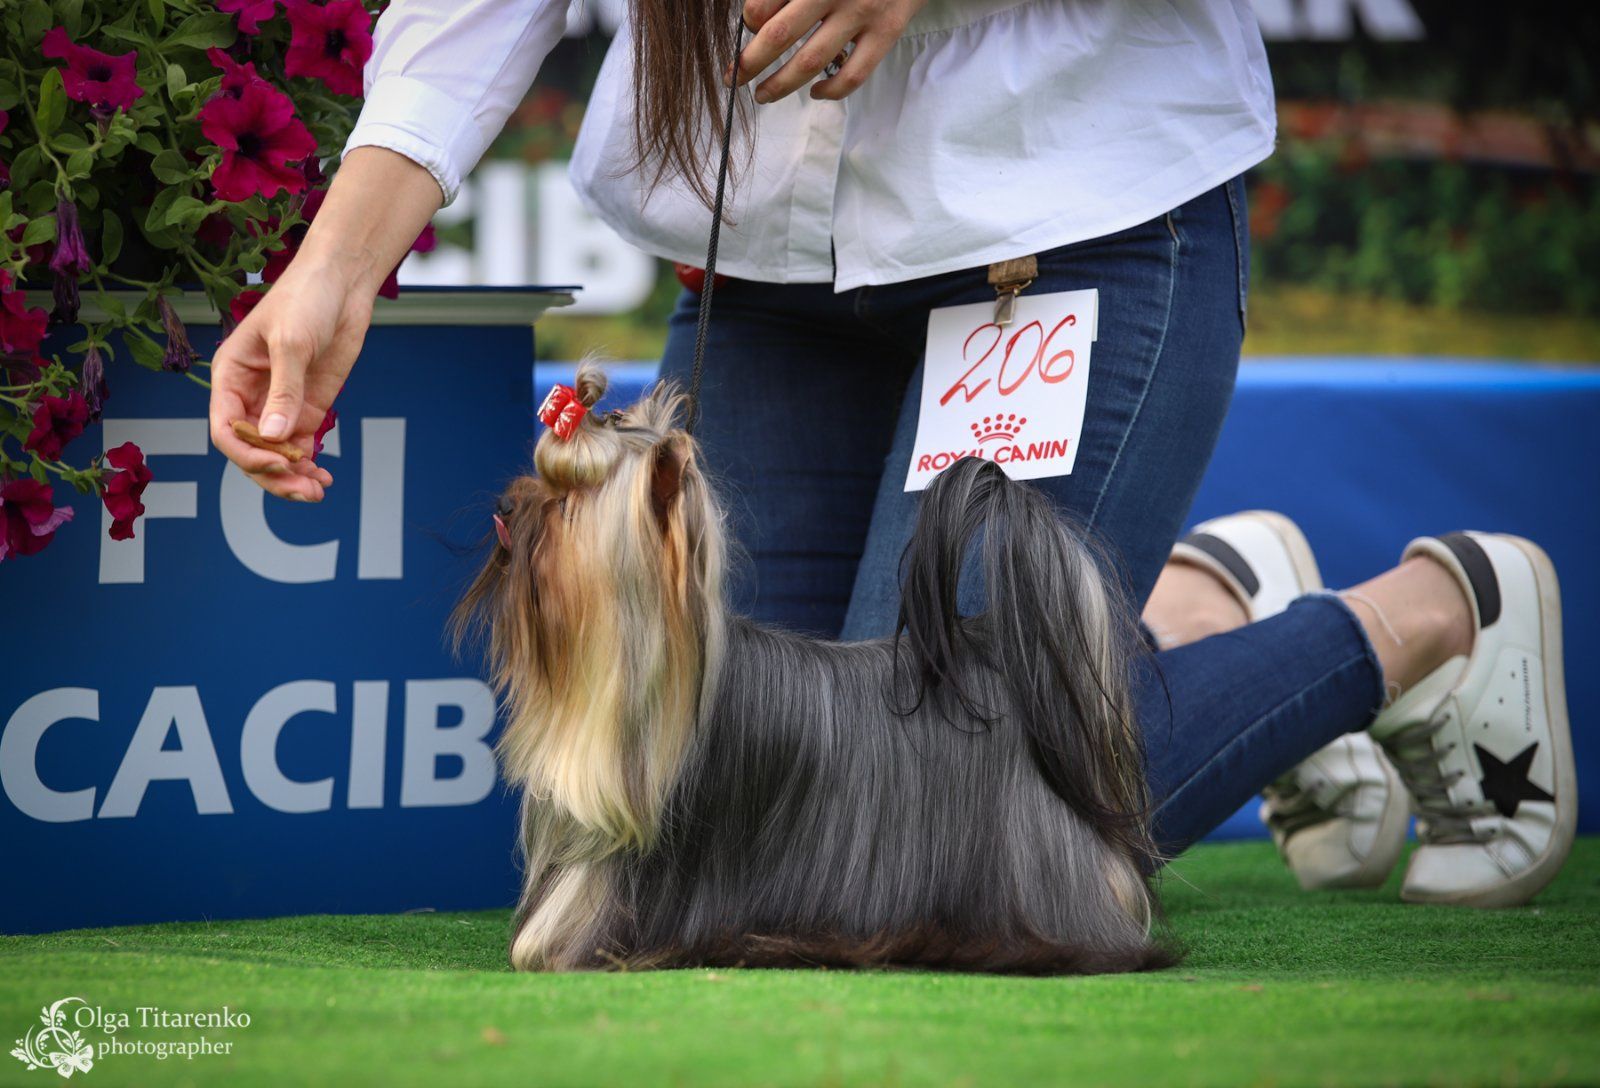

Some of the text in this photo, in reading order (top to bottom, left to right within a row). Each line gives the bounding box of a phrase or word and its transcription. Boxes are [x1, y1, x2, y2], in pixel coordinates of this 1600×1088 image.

[940, 314, 1076, 407] 206
[99, 417, 406, 584] FCI
[993, 439, 1068, 464] CANIN
[0, 678, 498, 823] CACIB
